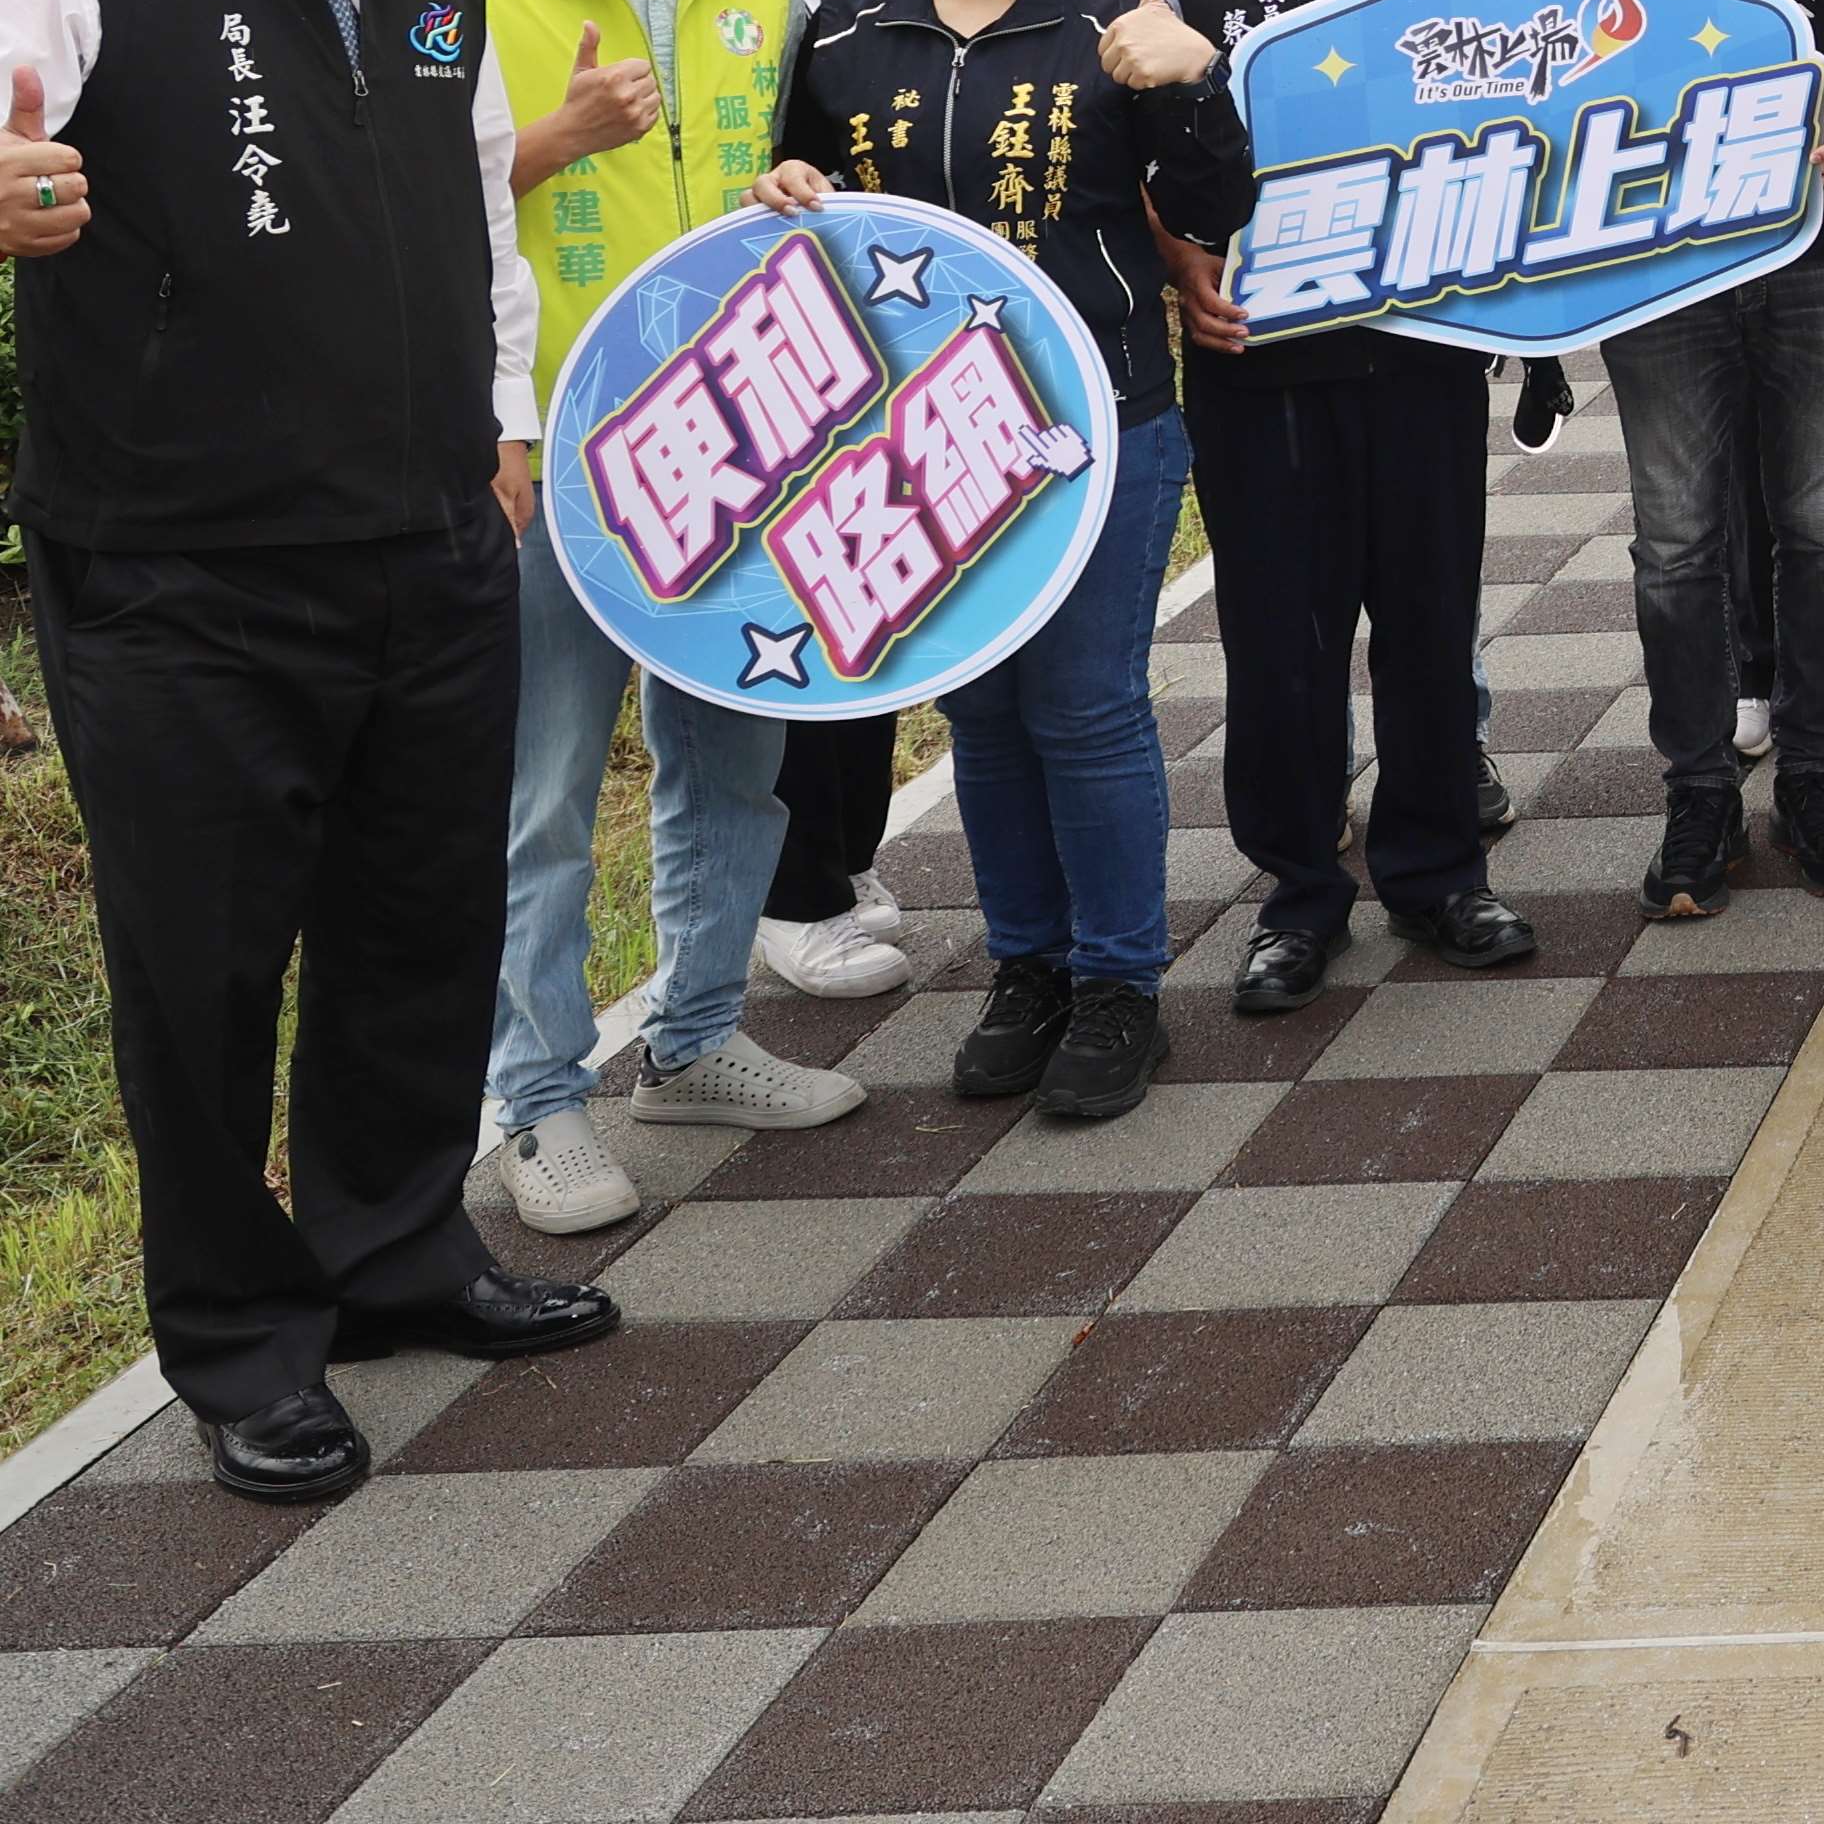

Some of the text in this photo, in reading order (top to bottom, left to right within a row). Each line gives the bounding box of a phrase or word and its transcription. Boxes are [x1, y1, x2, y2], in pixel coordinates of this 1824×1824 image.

[219, 13, 291, 238] 局長 汪令堯
[1399, 8, 1580, 99] 雲林上場
[1418, 79, 1526, 101] It's Our Time
[987, 82, 1037, 214] 王鈺齊
[1042, 82, 1079, 221] 雲林縣議員
[1238, 70, 1814, 322] 雲林上場
[597, 242, 874, 592] 便利
[777, 326, 1045, 666] 路網
